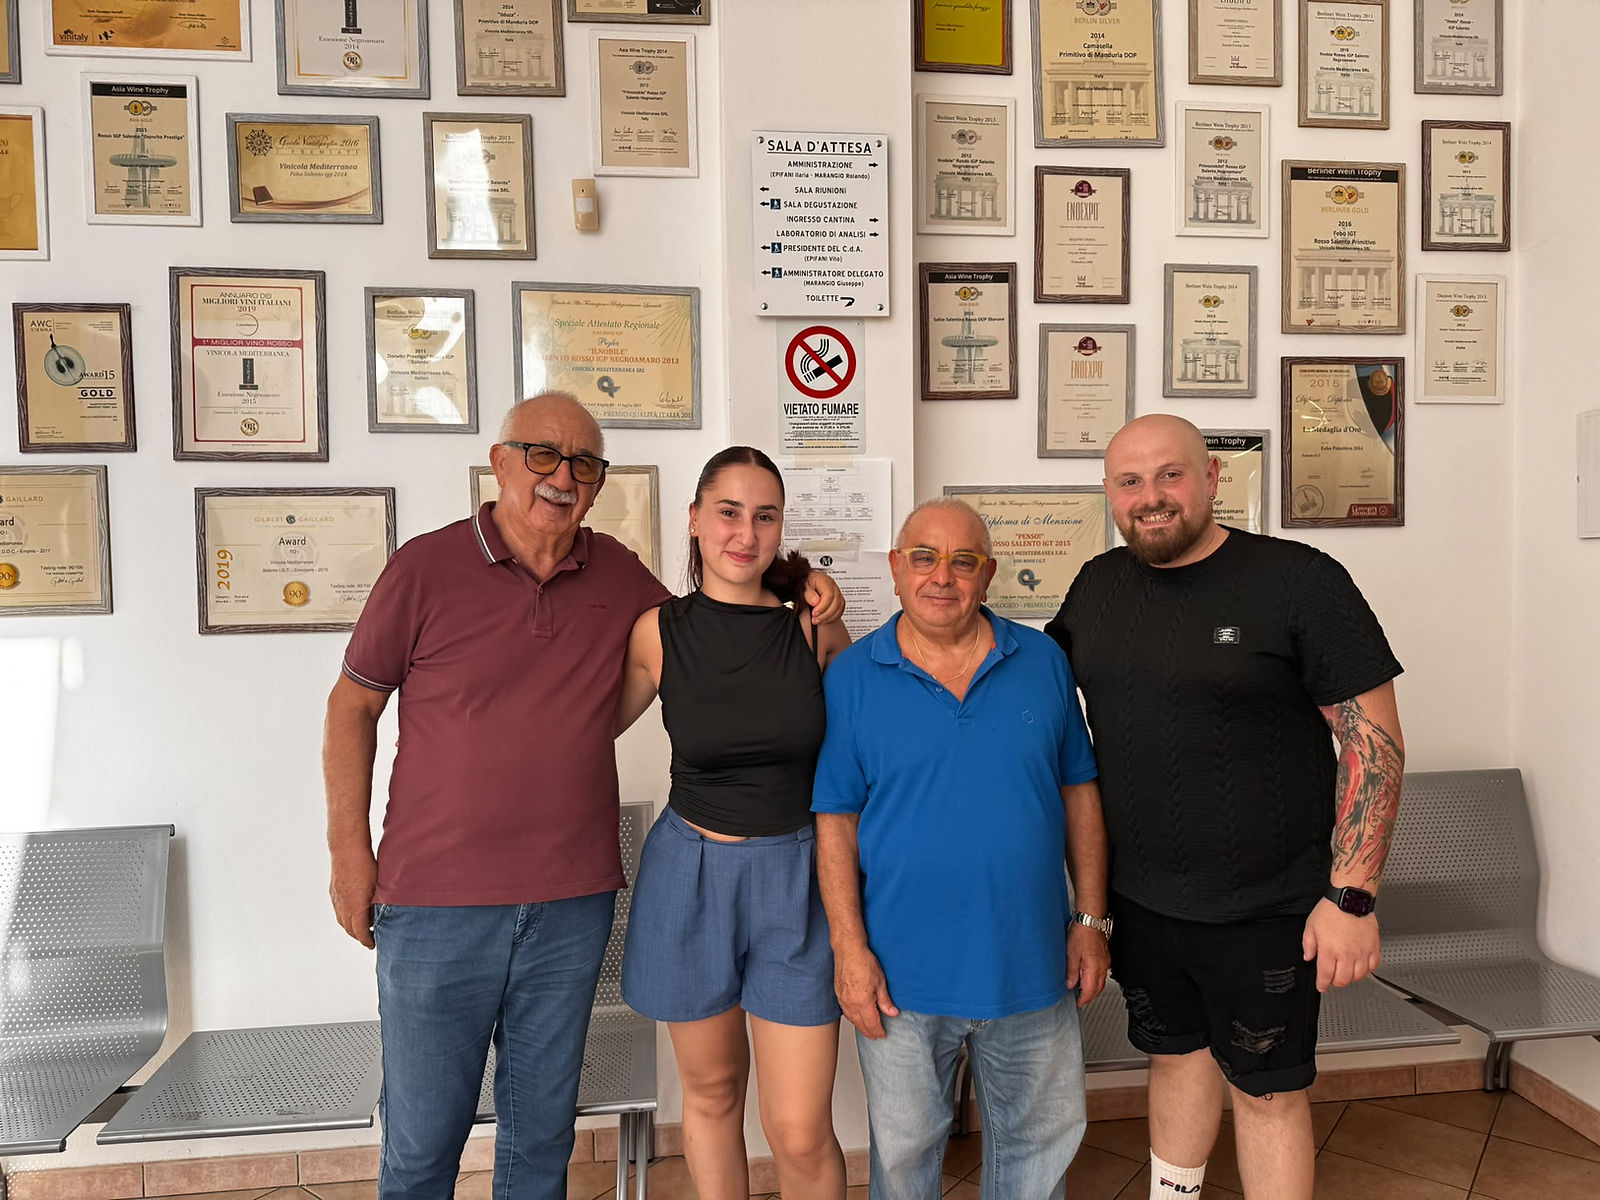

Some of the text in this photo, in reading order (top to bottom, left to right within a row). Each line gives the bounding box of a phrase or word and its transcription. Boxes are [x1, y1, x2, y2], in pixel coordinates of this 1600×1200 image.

[59, 32, 88, 42] vinitaly
[339, 139, 359, 147] 2016
[768, 140, 872, 153] SALA D'ATTESA
[776, 230, 827, 238] LABORATORIO
[554, 319, 660, 330] Speciale Attestato Regionale
[598, 338, 619, 348] Puglia
[610, 356, 660, 364] NEGROAMARO
[1310, 379, 1340, 388] 2015
[81, 389, 113, 397] GOLD
[784, 403, 859, 415] VIETATO FUMARE
[1220, 438, 1246, 446] Trophy
[1021, 516, 1031, 525] di
[1033, 513, 1083, 525] Menzione
[279, 537, 306, 546] Award
[216, 549, 233, 590] 2019
